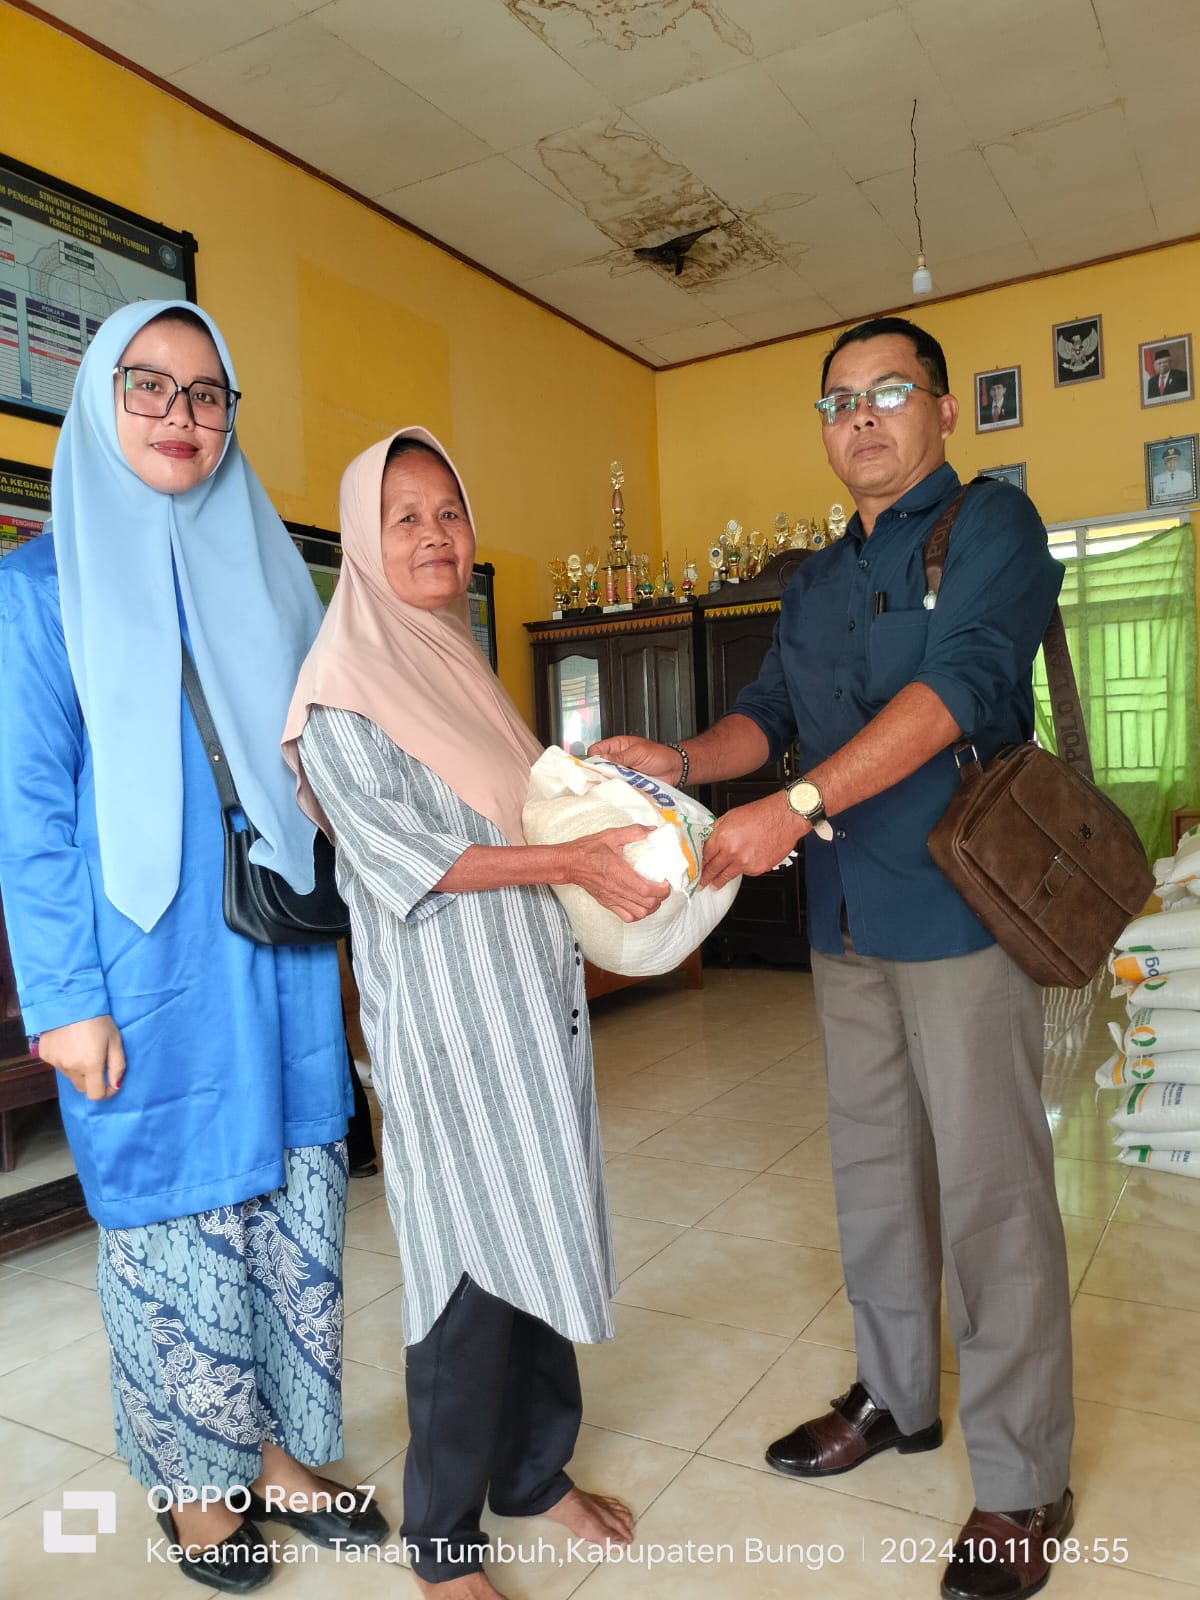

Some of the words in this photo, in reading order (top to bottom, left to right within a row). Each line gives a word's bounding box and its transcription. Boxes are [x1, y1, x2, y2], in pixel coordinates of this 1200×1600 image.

[7, 187, 55, 216] PENGGERAK
[56, 207, 72, 222] PKK
[73, 215, 97, 233] DUSUN
[99, 226, 121, 243] TANAH
[122, 236, 150, 255] TUMBUH
[72, 204, 108, 227] ORGANISASI
[0, 484, 23, 495] USUN
[25, 489, 50, 500] TANAH
[10, 478, 50, 492] KEGIATA
